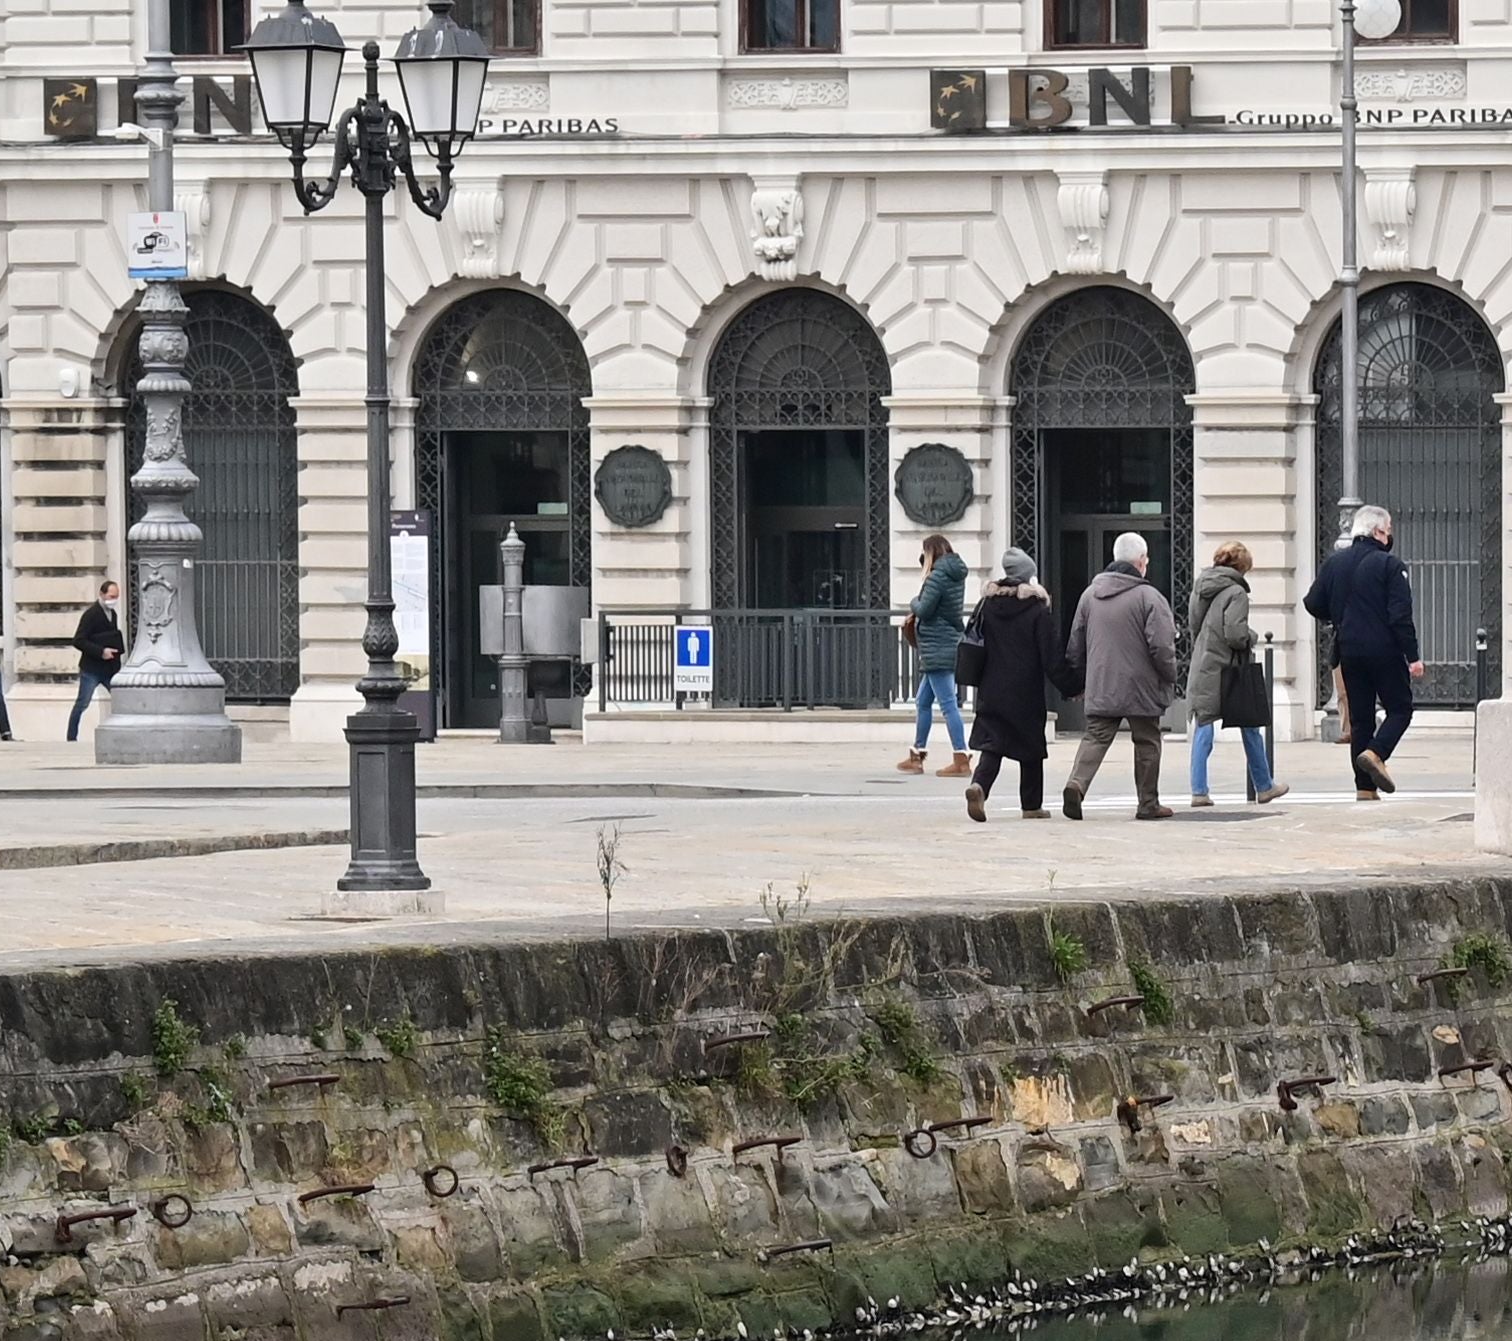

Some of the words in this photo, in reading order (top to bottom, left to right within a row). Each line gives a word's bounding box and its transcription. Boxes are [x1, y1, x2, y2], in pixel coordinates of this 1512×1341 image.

[1008, 66, 1226, 127] BNL
[1236, 109, 1333, 128] Gruppo
[503, 118, 619, 133] PARIBAS
[676, 675, 710, 683] TOILETTE
